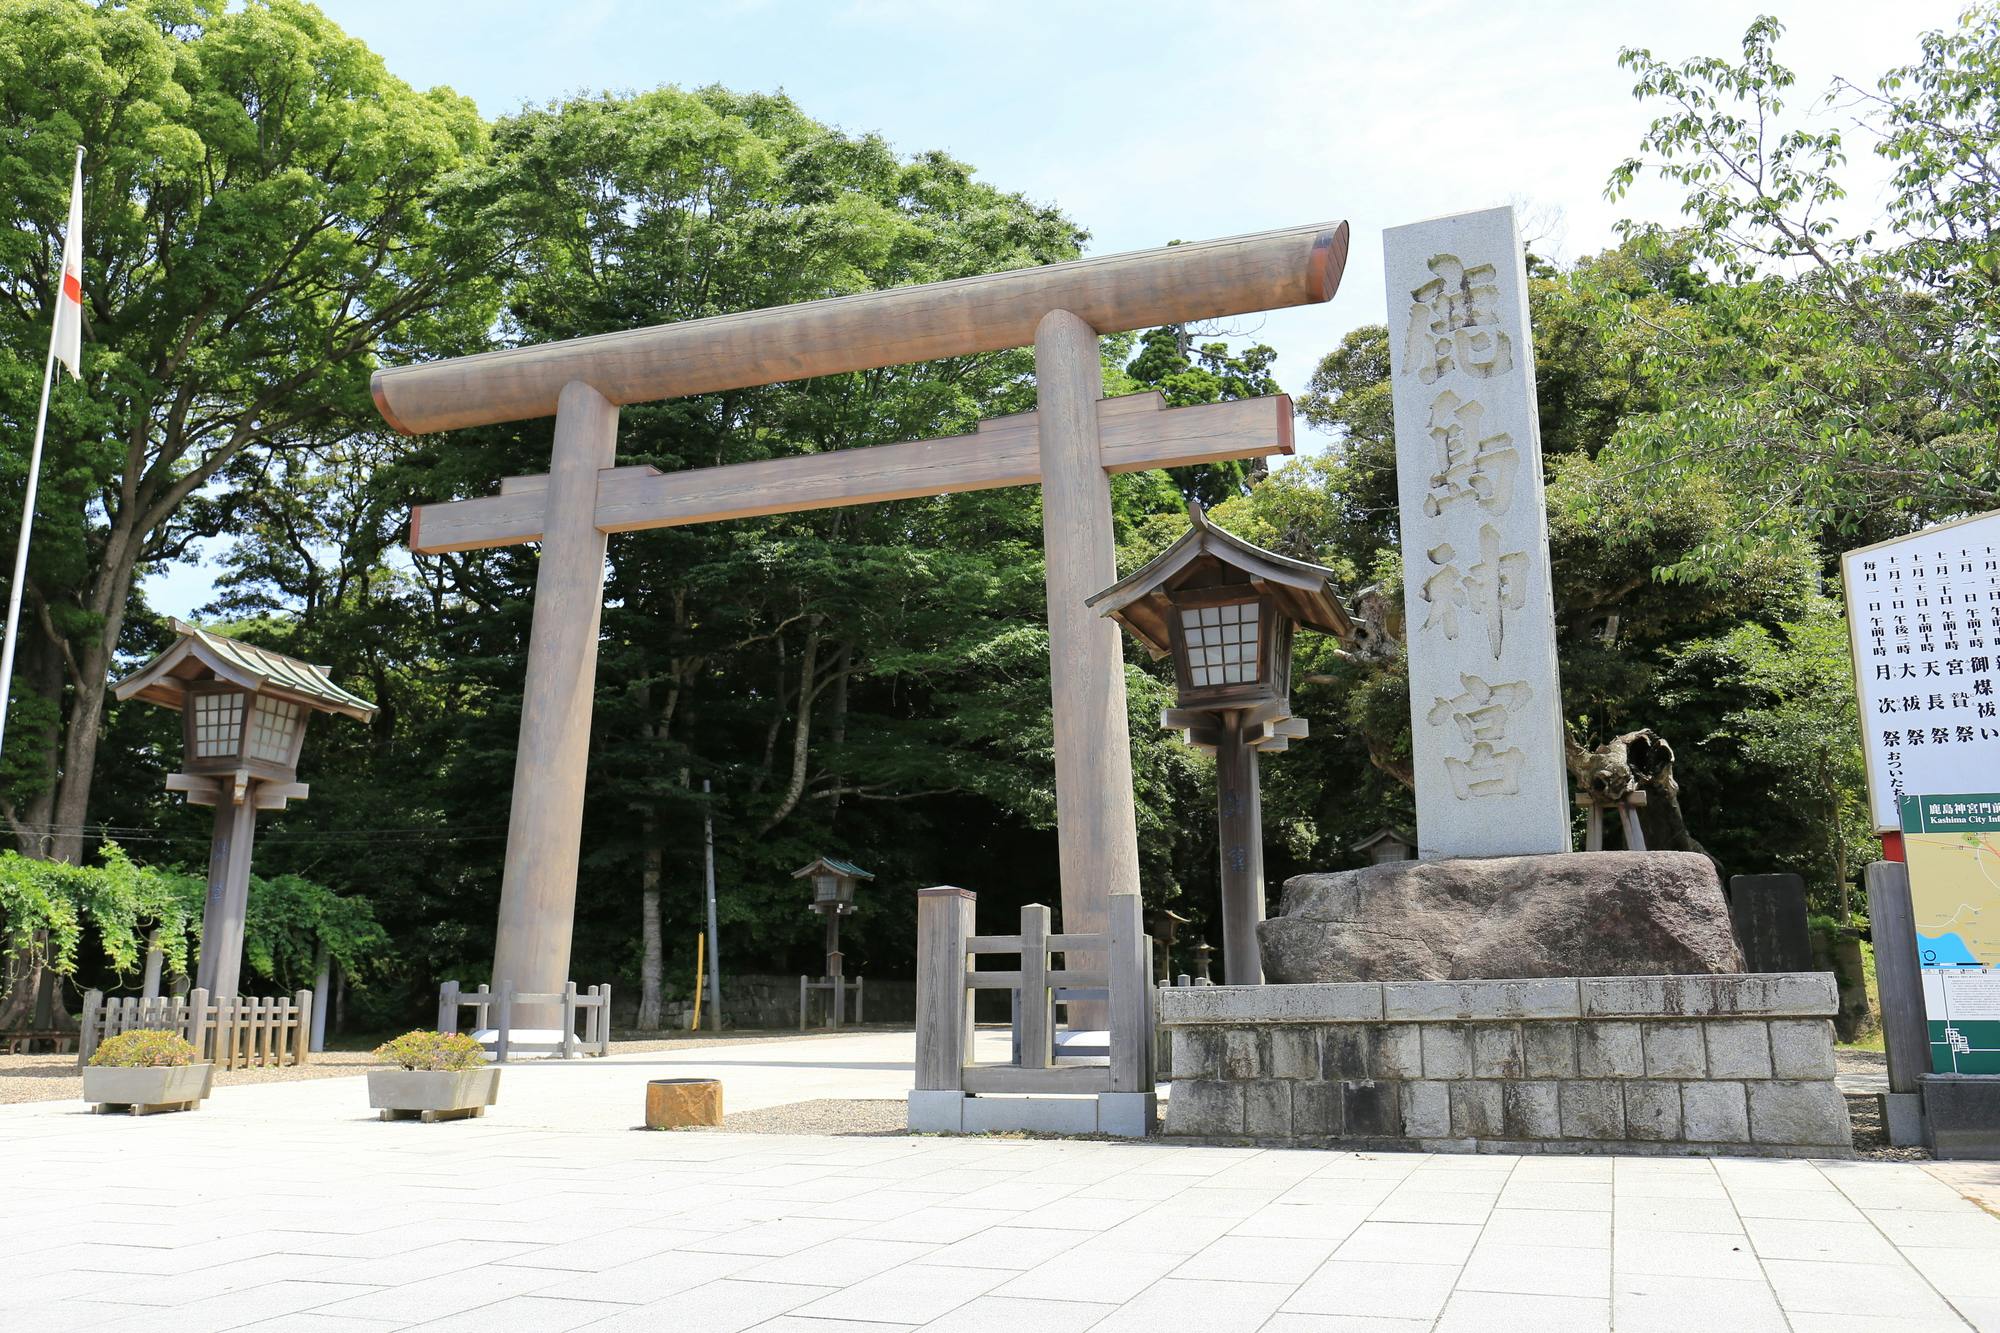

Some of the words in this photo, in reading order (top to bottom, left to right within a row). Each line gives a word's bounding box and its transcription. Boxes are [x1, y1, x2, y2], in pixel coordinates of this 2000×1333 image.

[1402, 252, 1534, 801] 鹿島神宮
[1876, 663, 1901, 748] 月次祭
[1899, 662, 1925, 746] 大祓祭
[1921, 660, 1949, 745] 天長祭
[1970, 656, 1999, 741] 御煤祓い
[1929, 816, 1967, 824] Kashima
[1968, 815, 1987, 825] City
